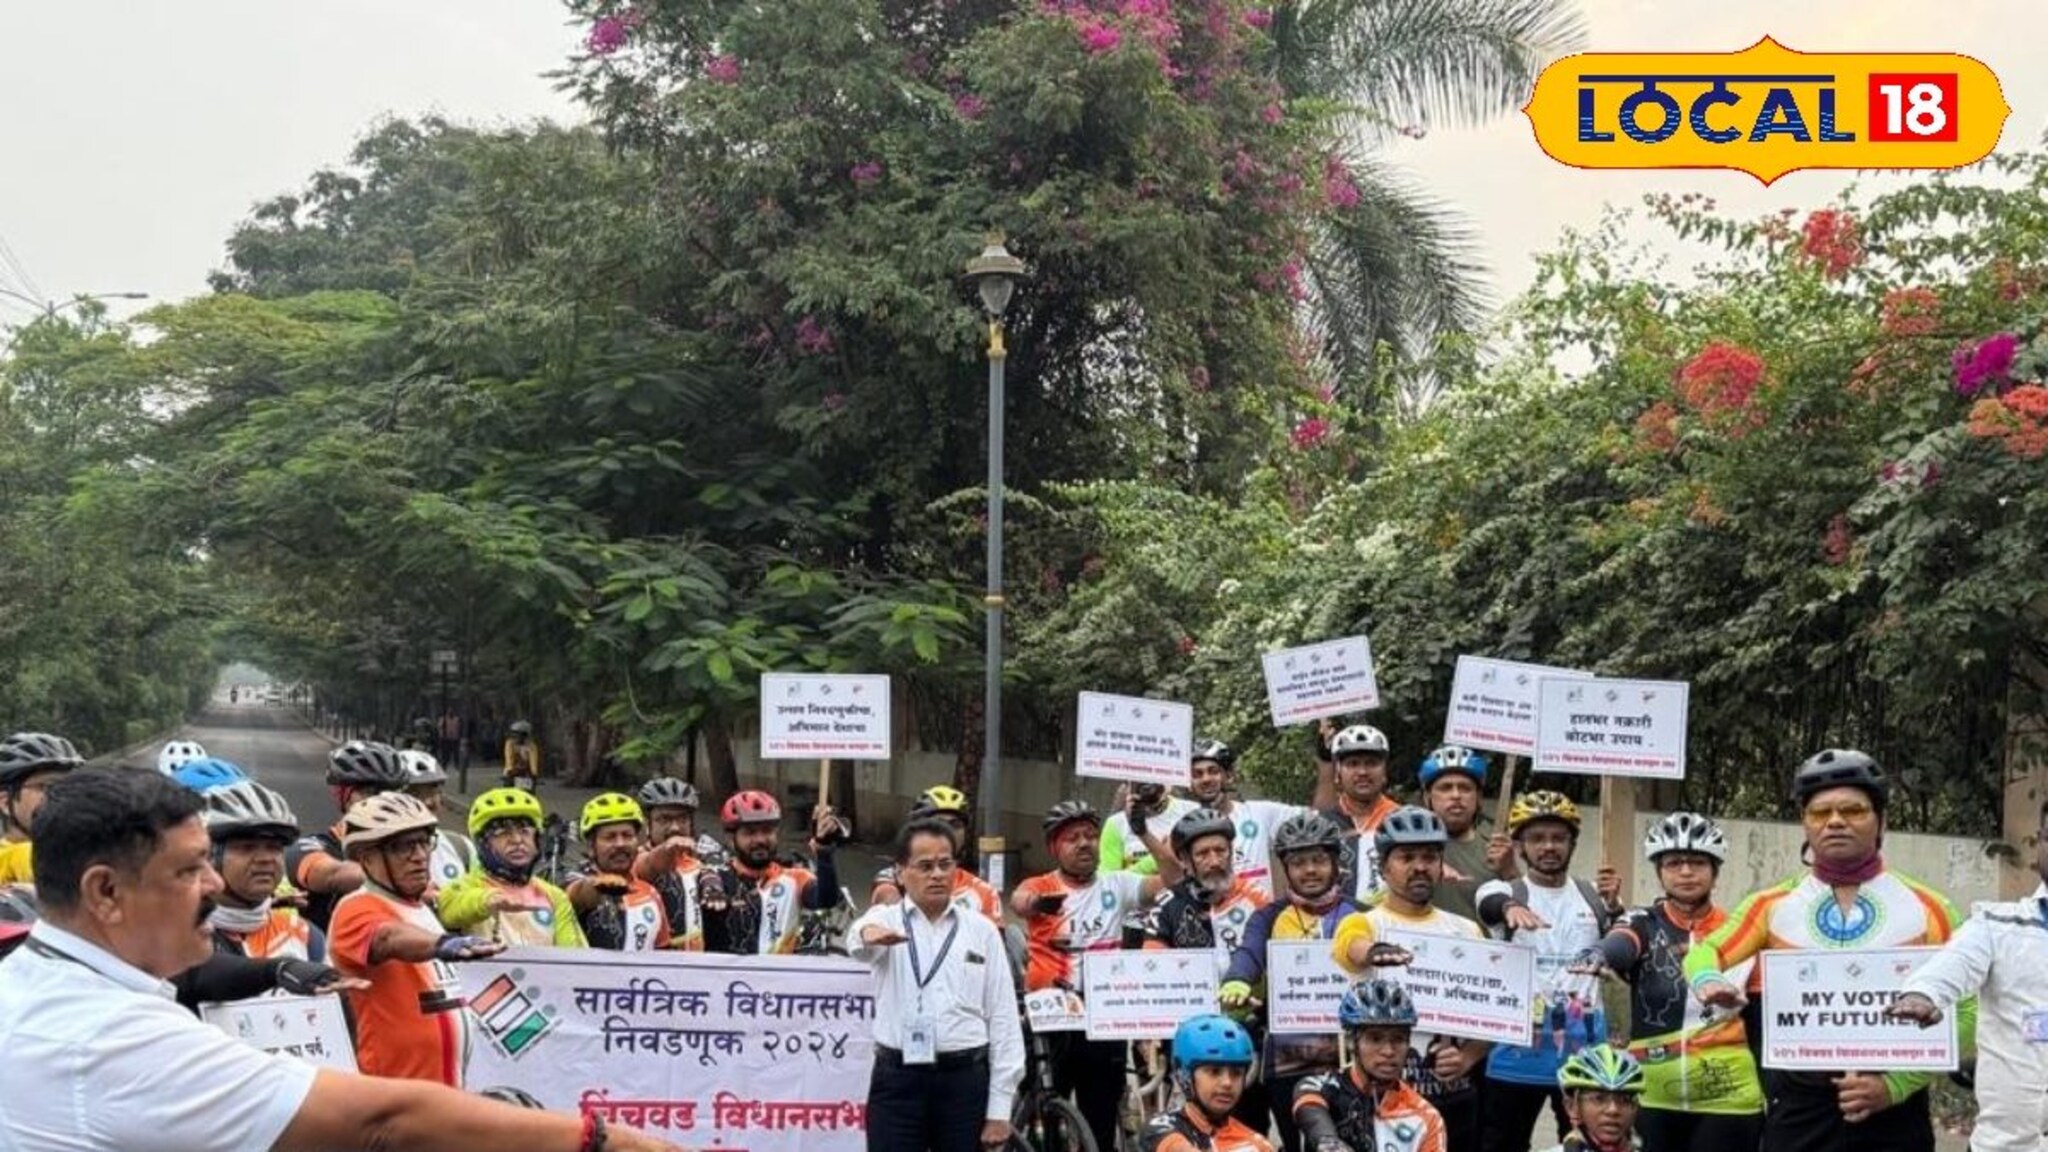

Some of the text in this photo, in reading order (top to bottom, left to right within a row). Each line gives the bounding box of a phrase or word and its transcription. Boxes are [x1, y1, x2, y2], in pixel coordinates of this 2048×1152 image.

[572, 977, 876, 1021] सार्वत्रिक विधानसभा
[1801, 990, 1834, 1007] MY
[1777, 1012, 1810, 1028] MY
[601, 1014, 747, 1066] निवडणूक
[762, 1029, 850, 1061] २०२४
